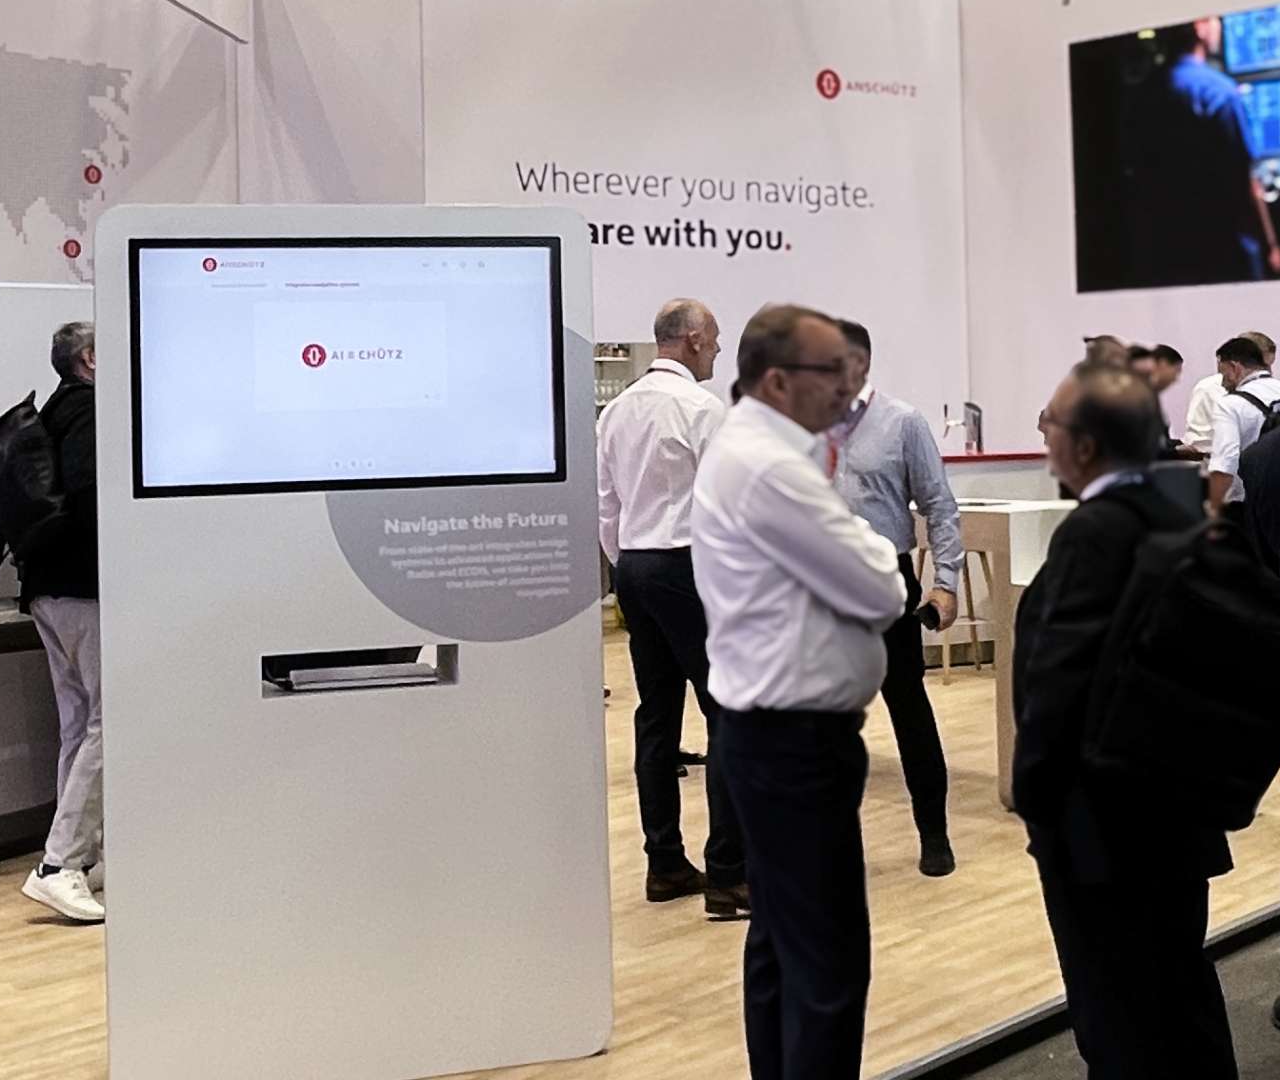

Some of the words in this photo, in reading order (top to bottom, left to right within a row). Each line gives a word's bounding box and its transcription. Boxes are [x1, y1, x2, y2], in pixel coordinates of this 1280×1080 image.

[846, 80, 918, 98] ANSCHÜTZ
[515, 161, 674, 198] Wherever
[680, 177, 736, 207] you
[745, 176, 875, 214] navigate.
[644, 218, 718, 249] with
[725, 226, 792, 257] you.
[383, 516, 470, 537] Navigate
[470, 514, 504, 530] the
[507, 512, 569, 528] Future
